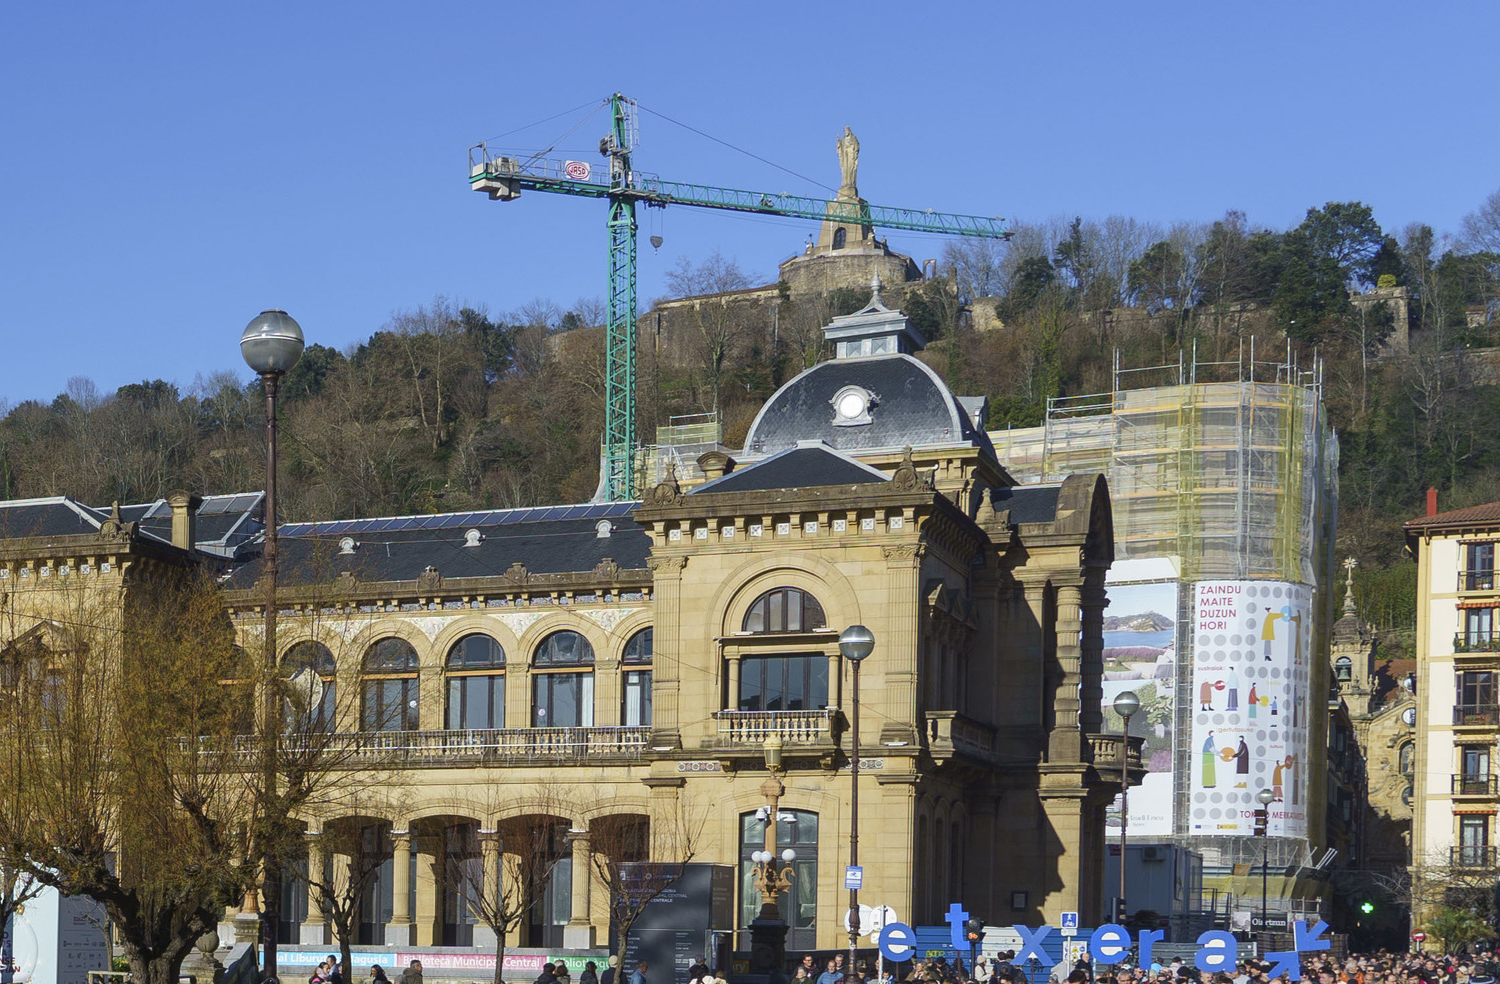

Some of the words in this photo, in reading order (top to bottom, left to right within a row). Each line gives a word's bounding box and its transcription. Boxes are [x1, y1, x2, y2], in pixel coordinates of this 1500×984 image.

[570, 166, 586, 175] JASO
[1200, 585, 1241, 595] ZAINDU
[1200, 597, 1233, 606] MAITE
[1200, 609, 1237, 618] DUZUN
[1200, 621, 1227, 630] HORI
[351, 955, 388, 965] agusia
[453, 956, 497, 969] Municipa
[504, 957, 540, 967] Central
